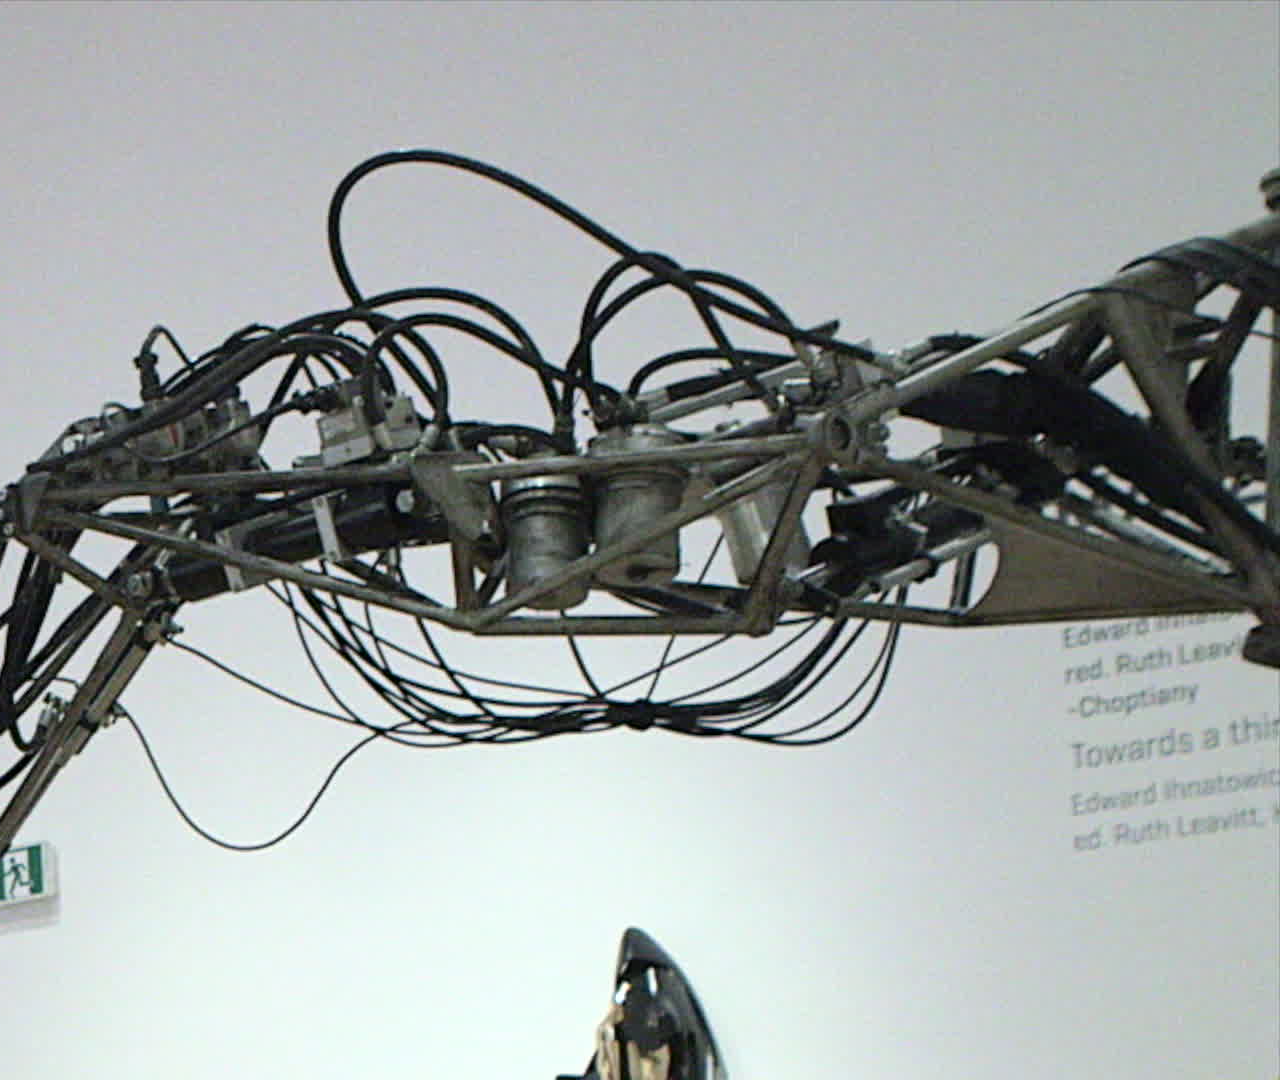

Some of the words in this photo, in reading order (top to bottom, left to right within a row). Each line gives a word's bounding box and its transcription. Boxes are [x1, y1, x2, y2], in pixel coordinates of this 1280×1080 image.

[1115, 648, 1173, 673] Ruth
[1071, 728, 1193, 768] Towards
[1201, 727, 1220, 750] a
[1070, 782, 1157, 816] Edward
[1114, 818, 1170, 845] Ruth
